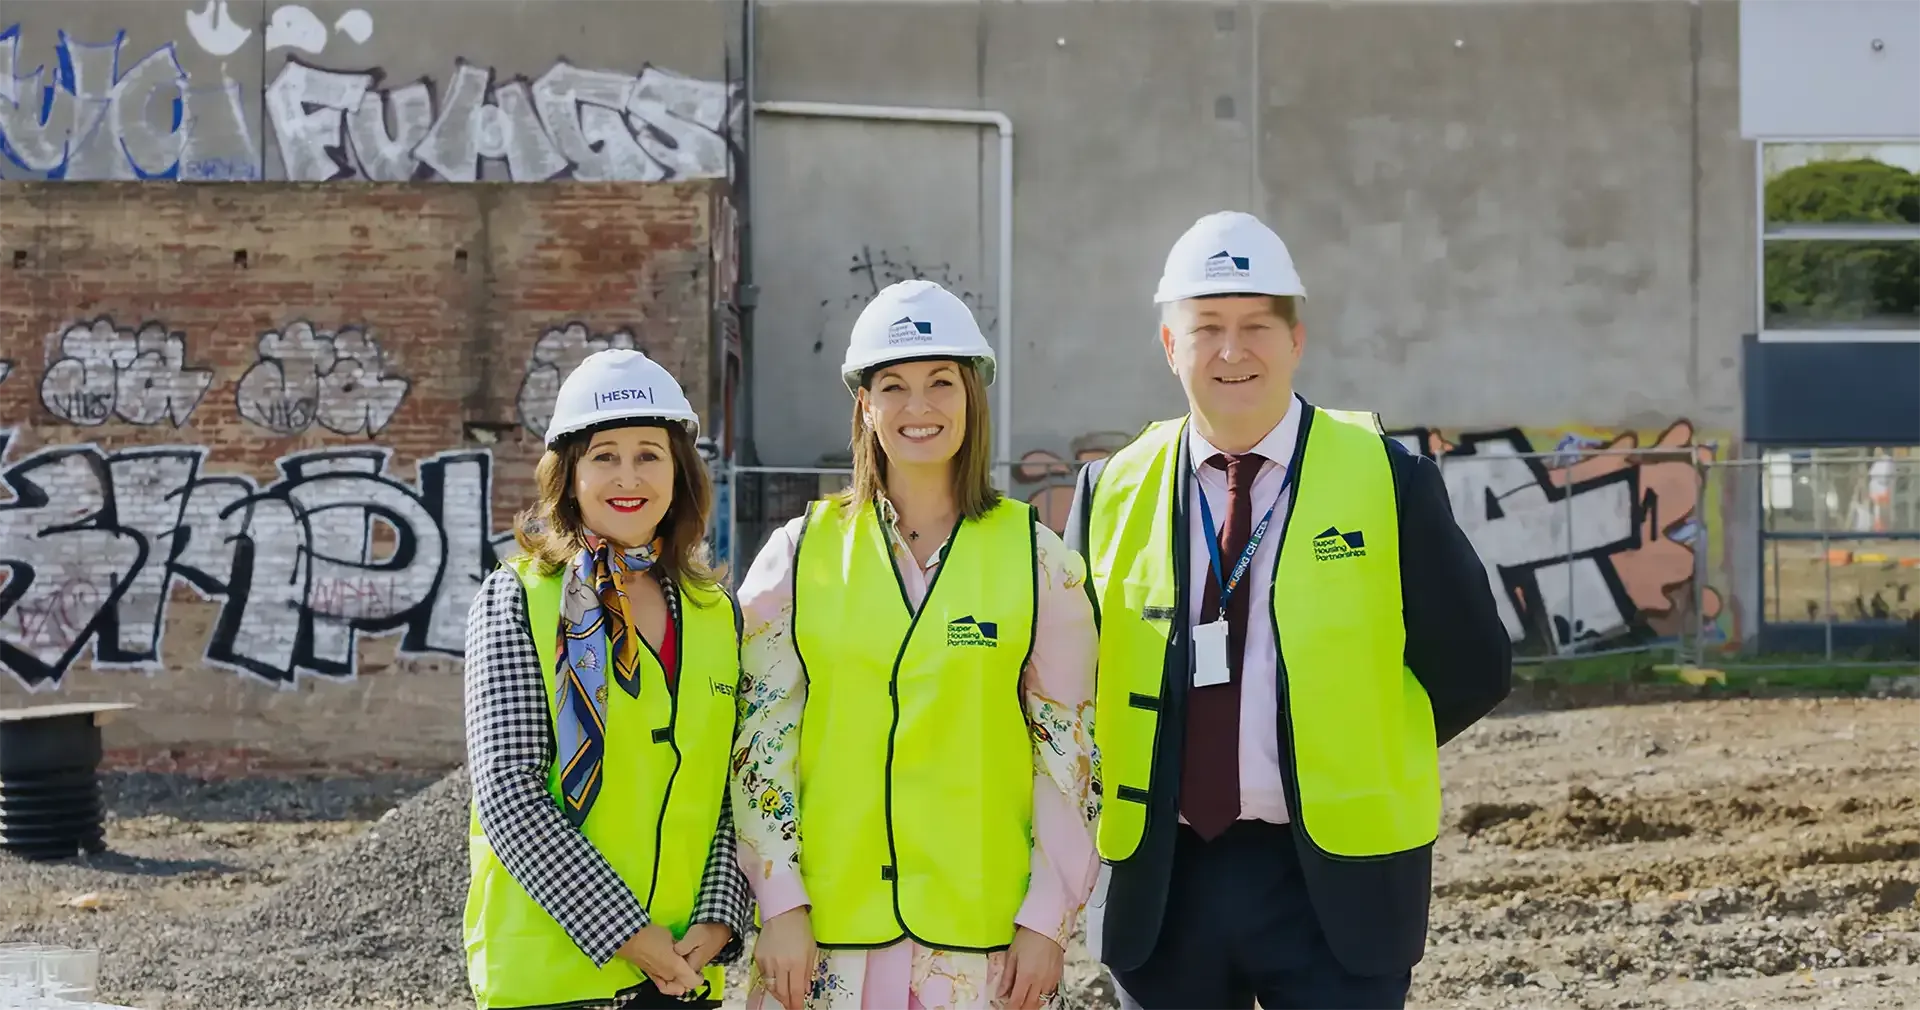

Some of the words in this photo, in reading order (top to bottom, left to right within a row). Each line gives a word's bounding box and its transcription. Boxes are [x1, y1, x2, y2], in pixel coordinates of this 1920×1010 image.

[601, 389, 647, 403] HESTA
[1313, 538, 1337, 547] Super
[1314, 544, 1347, 554] Housing
[1316, 550, 1367, 562] Partnerships
[947, 624, 972, 632] Super
[947, 632, 980, 640] Housing
[947, 639, 998, 648] Partnerships
[713, 681, 735, 696] HEST
